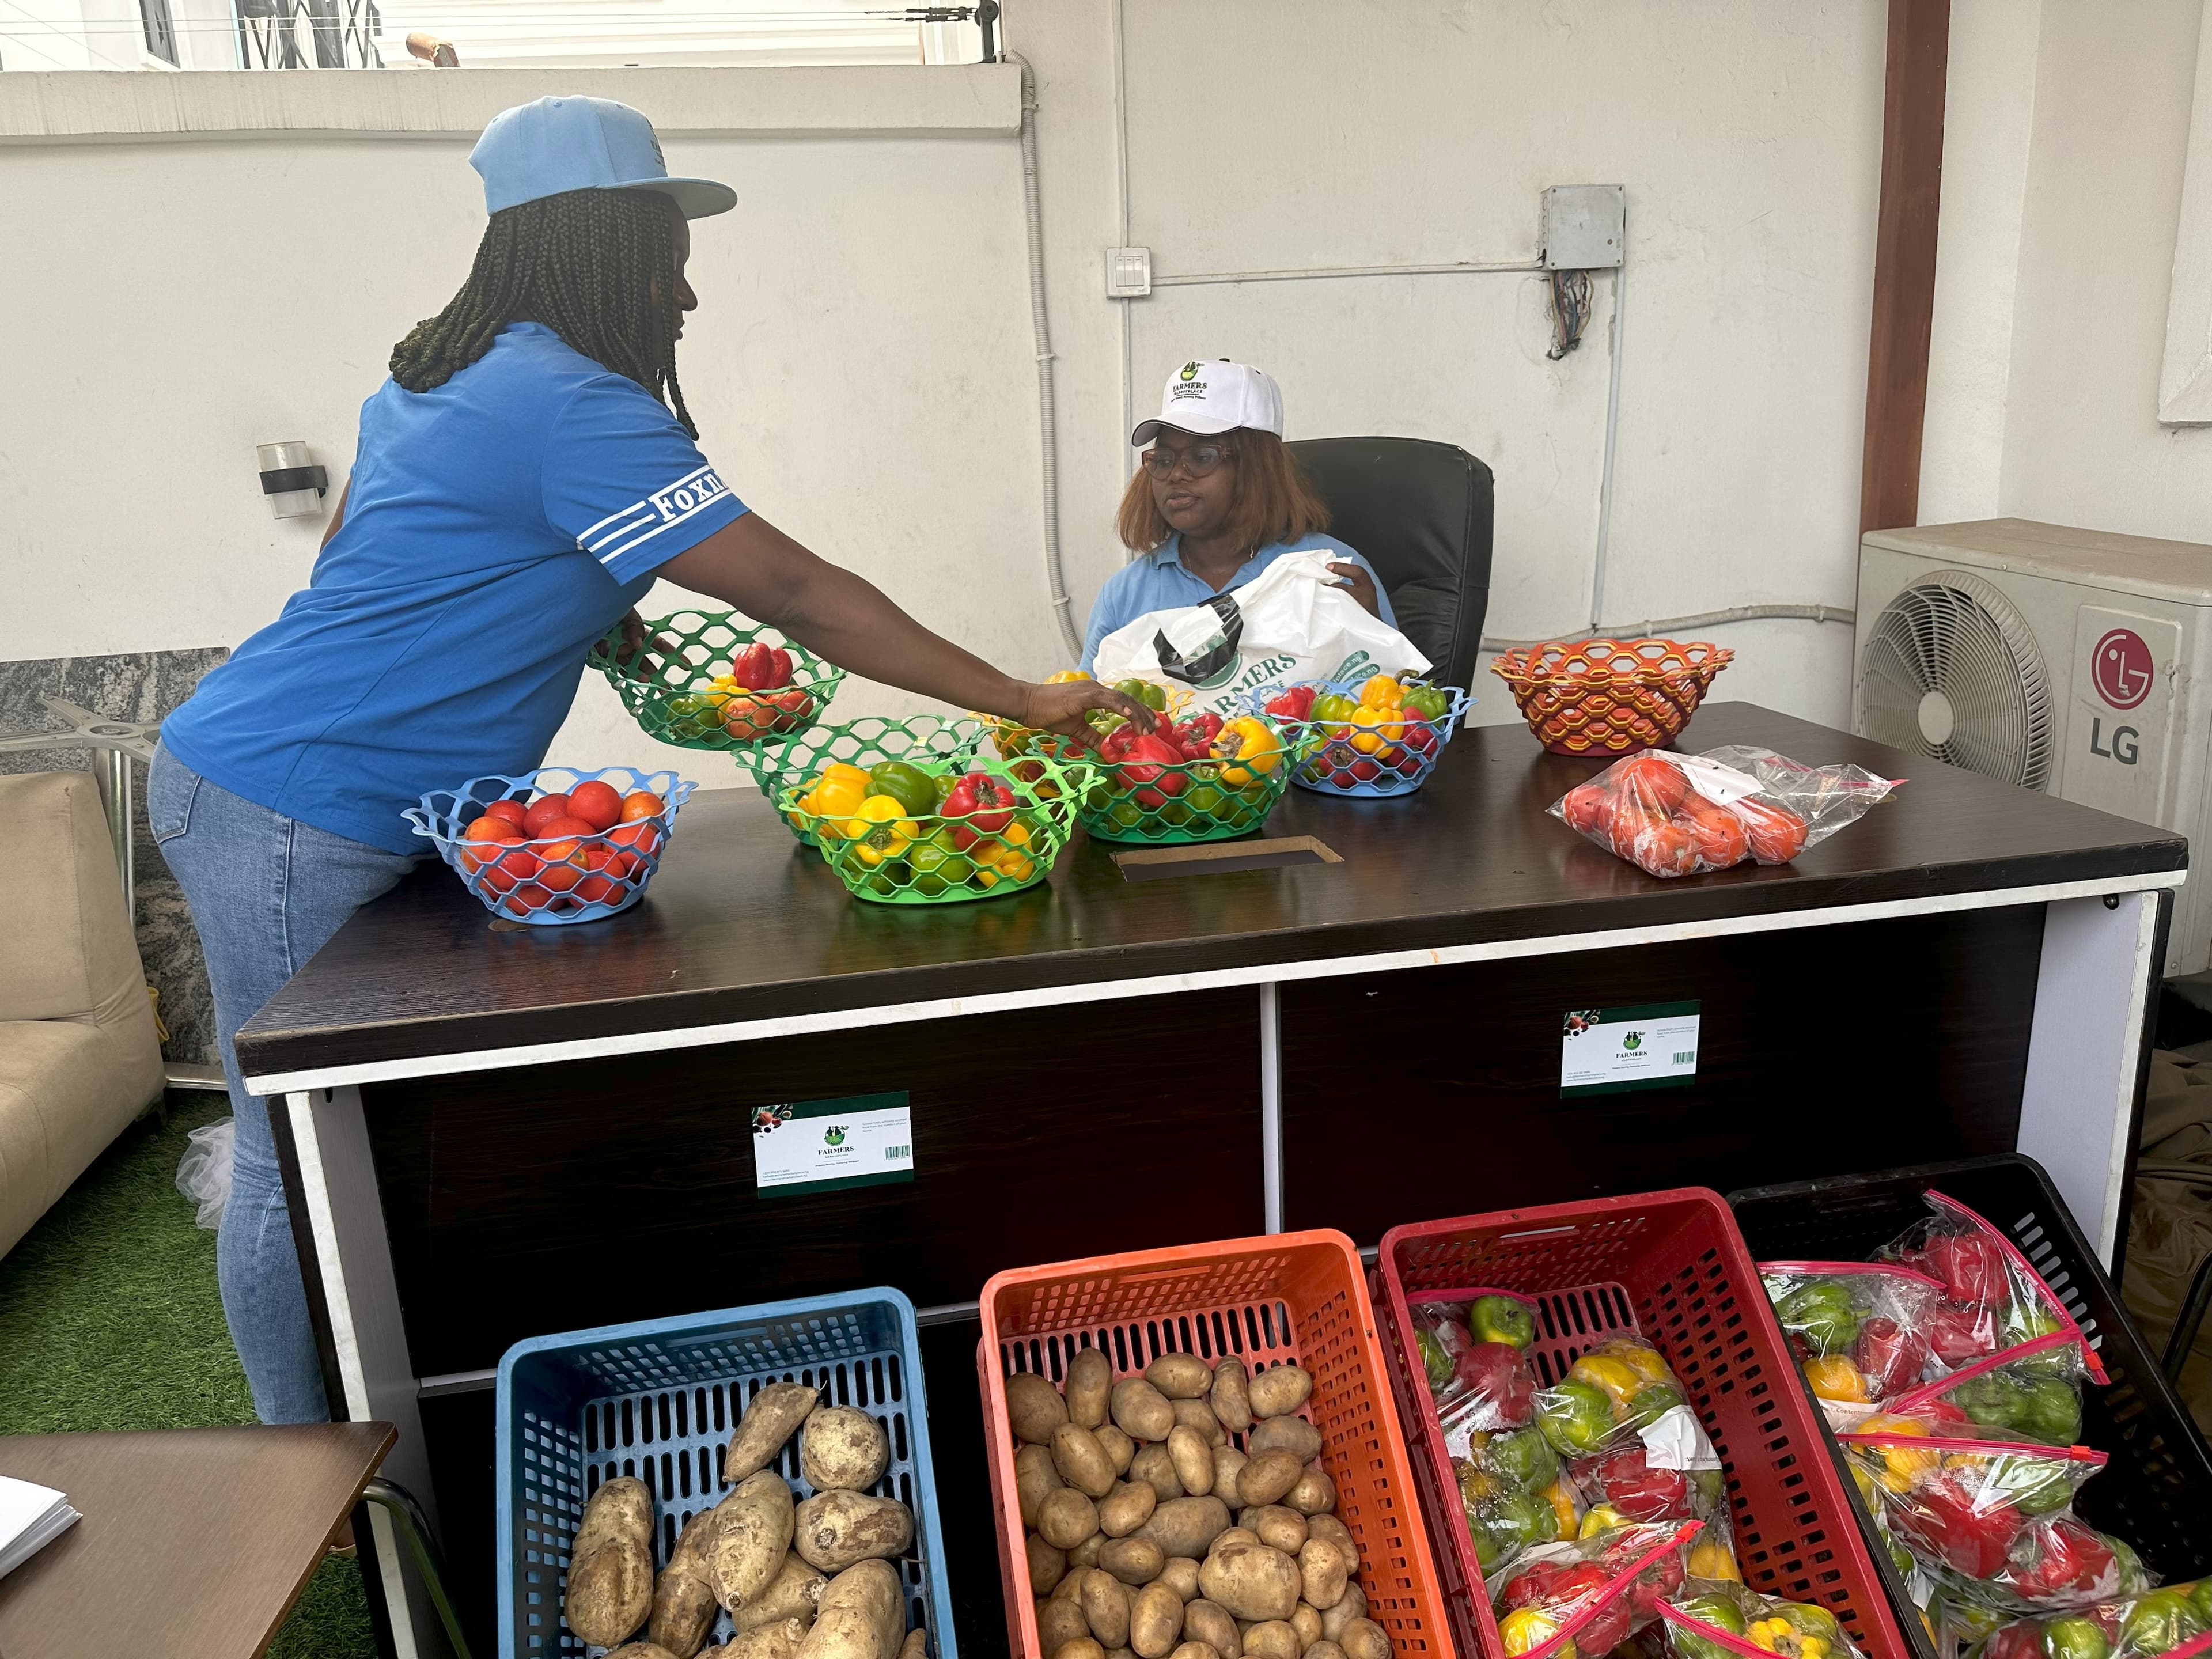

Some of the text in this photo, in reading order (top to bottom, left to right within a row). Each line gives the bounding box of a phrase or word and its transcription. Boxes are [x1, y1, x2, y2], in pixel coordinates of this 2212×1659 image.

[1173, 382, 1207, 392] FARMERS
[647, 471, 728, 522] Foxn
[1203, 653, 1296, 717] ARMERS
[2090, 717, 2139, 765] LG
[1616, 1051, 1647, 1059] FARMERS
[818, 1146, 854, 1155] FARMERS
